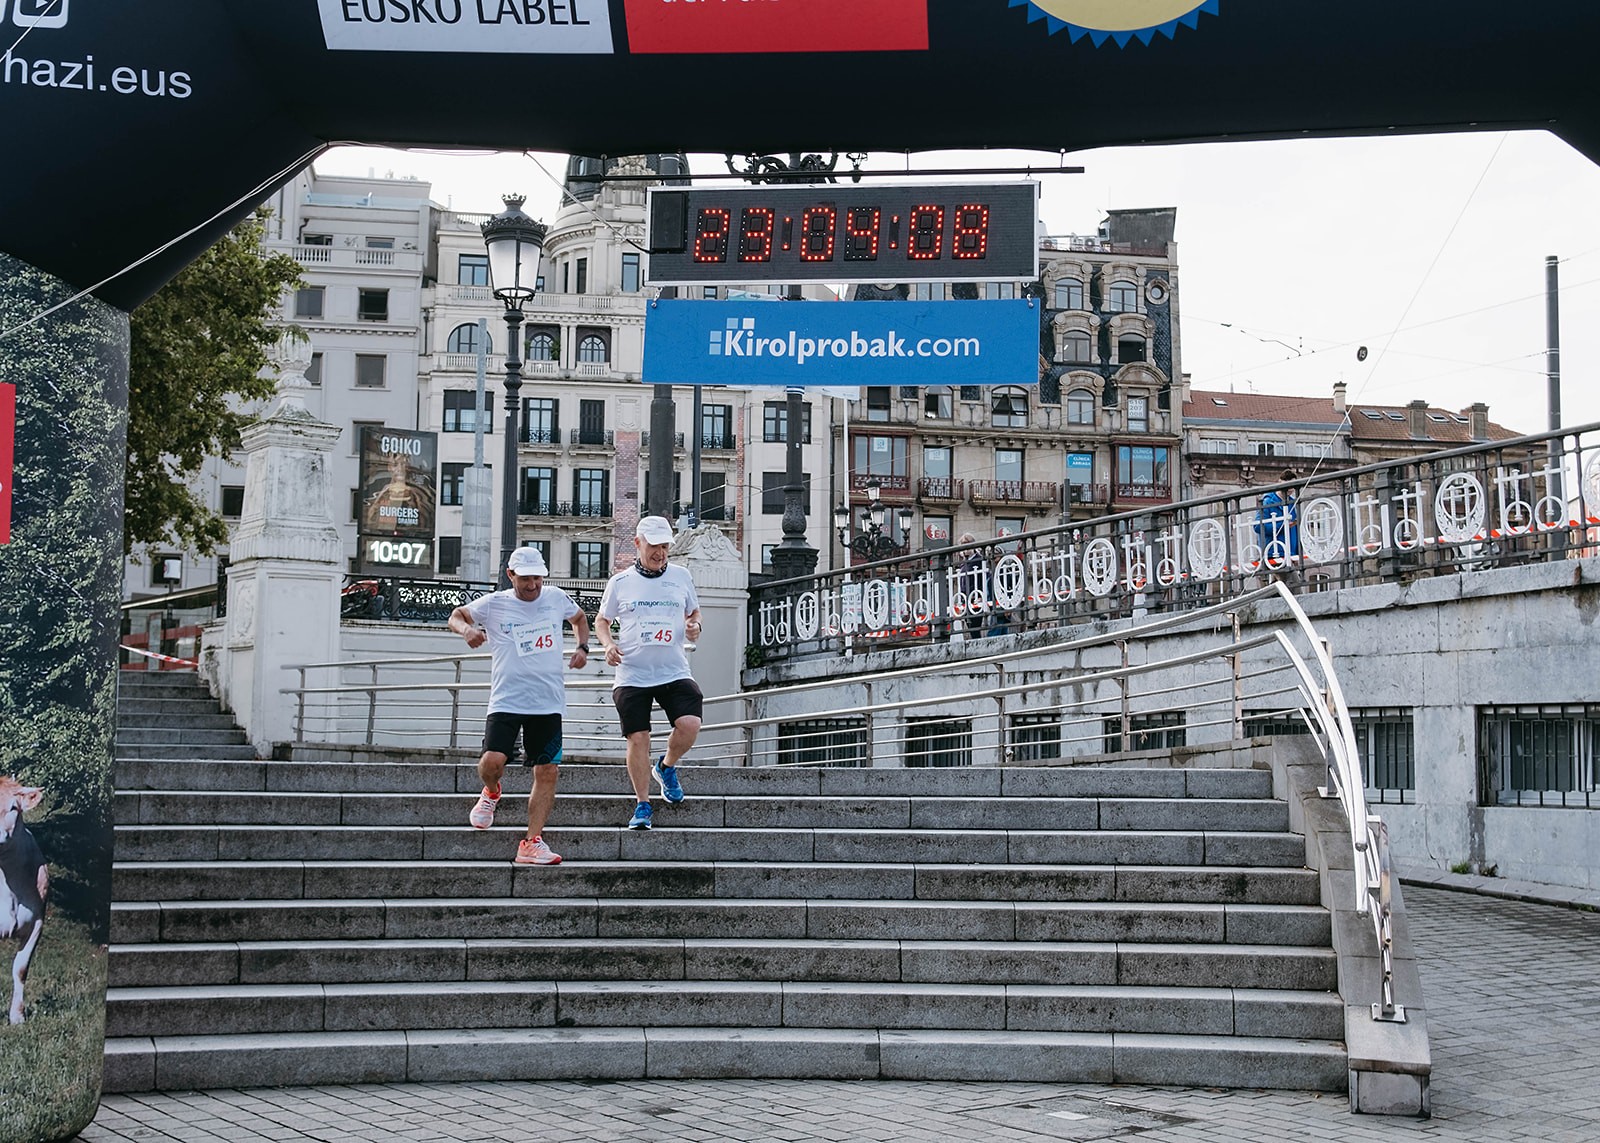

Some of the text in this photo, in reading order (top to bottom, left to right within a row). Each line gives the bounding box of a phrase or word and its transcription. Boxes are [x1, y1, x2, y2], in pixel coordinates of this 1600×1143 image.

[341, 0, 591, 26] EUSKO LABEL
[4, 50, 192, 99] hazi.eus
[694, 205, 989, 262] 23:04:08
[723, 322, 980, 365] Kirolprobak.com
[381, 436, 421, 456] GOIKO
[379, 505, 419, 519] BURGERS
[370, 540, 426, 565] 10:07
[637, 600, 680, 608] mayoractivo
[535, 634, 553, 649] 45
[654, 629, 673, 643] 45
